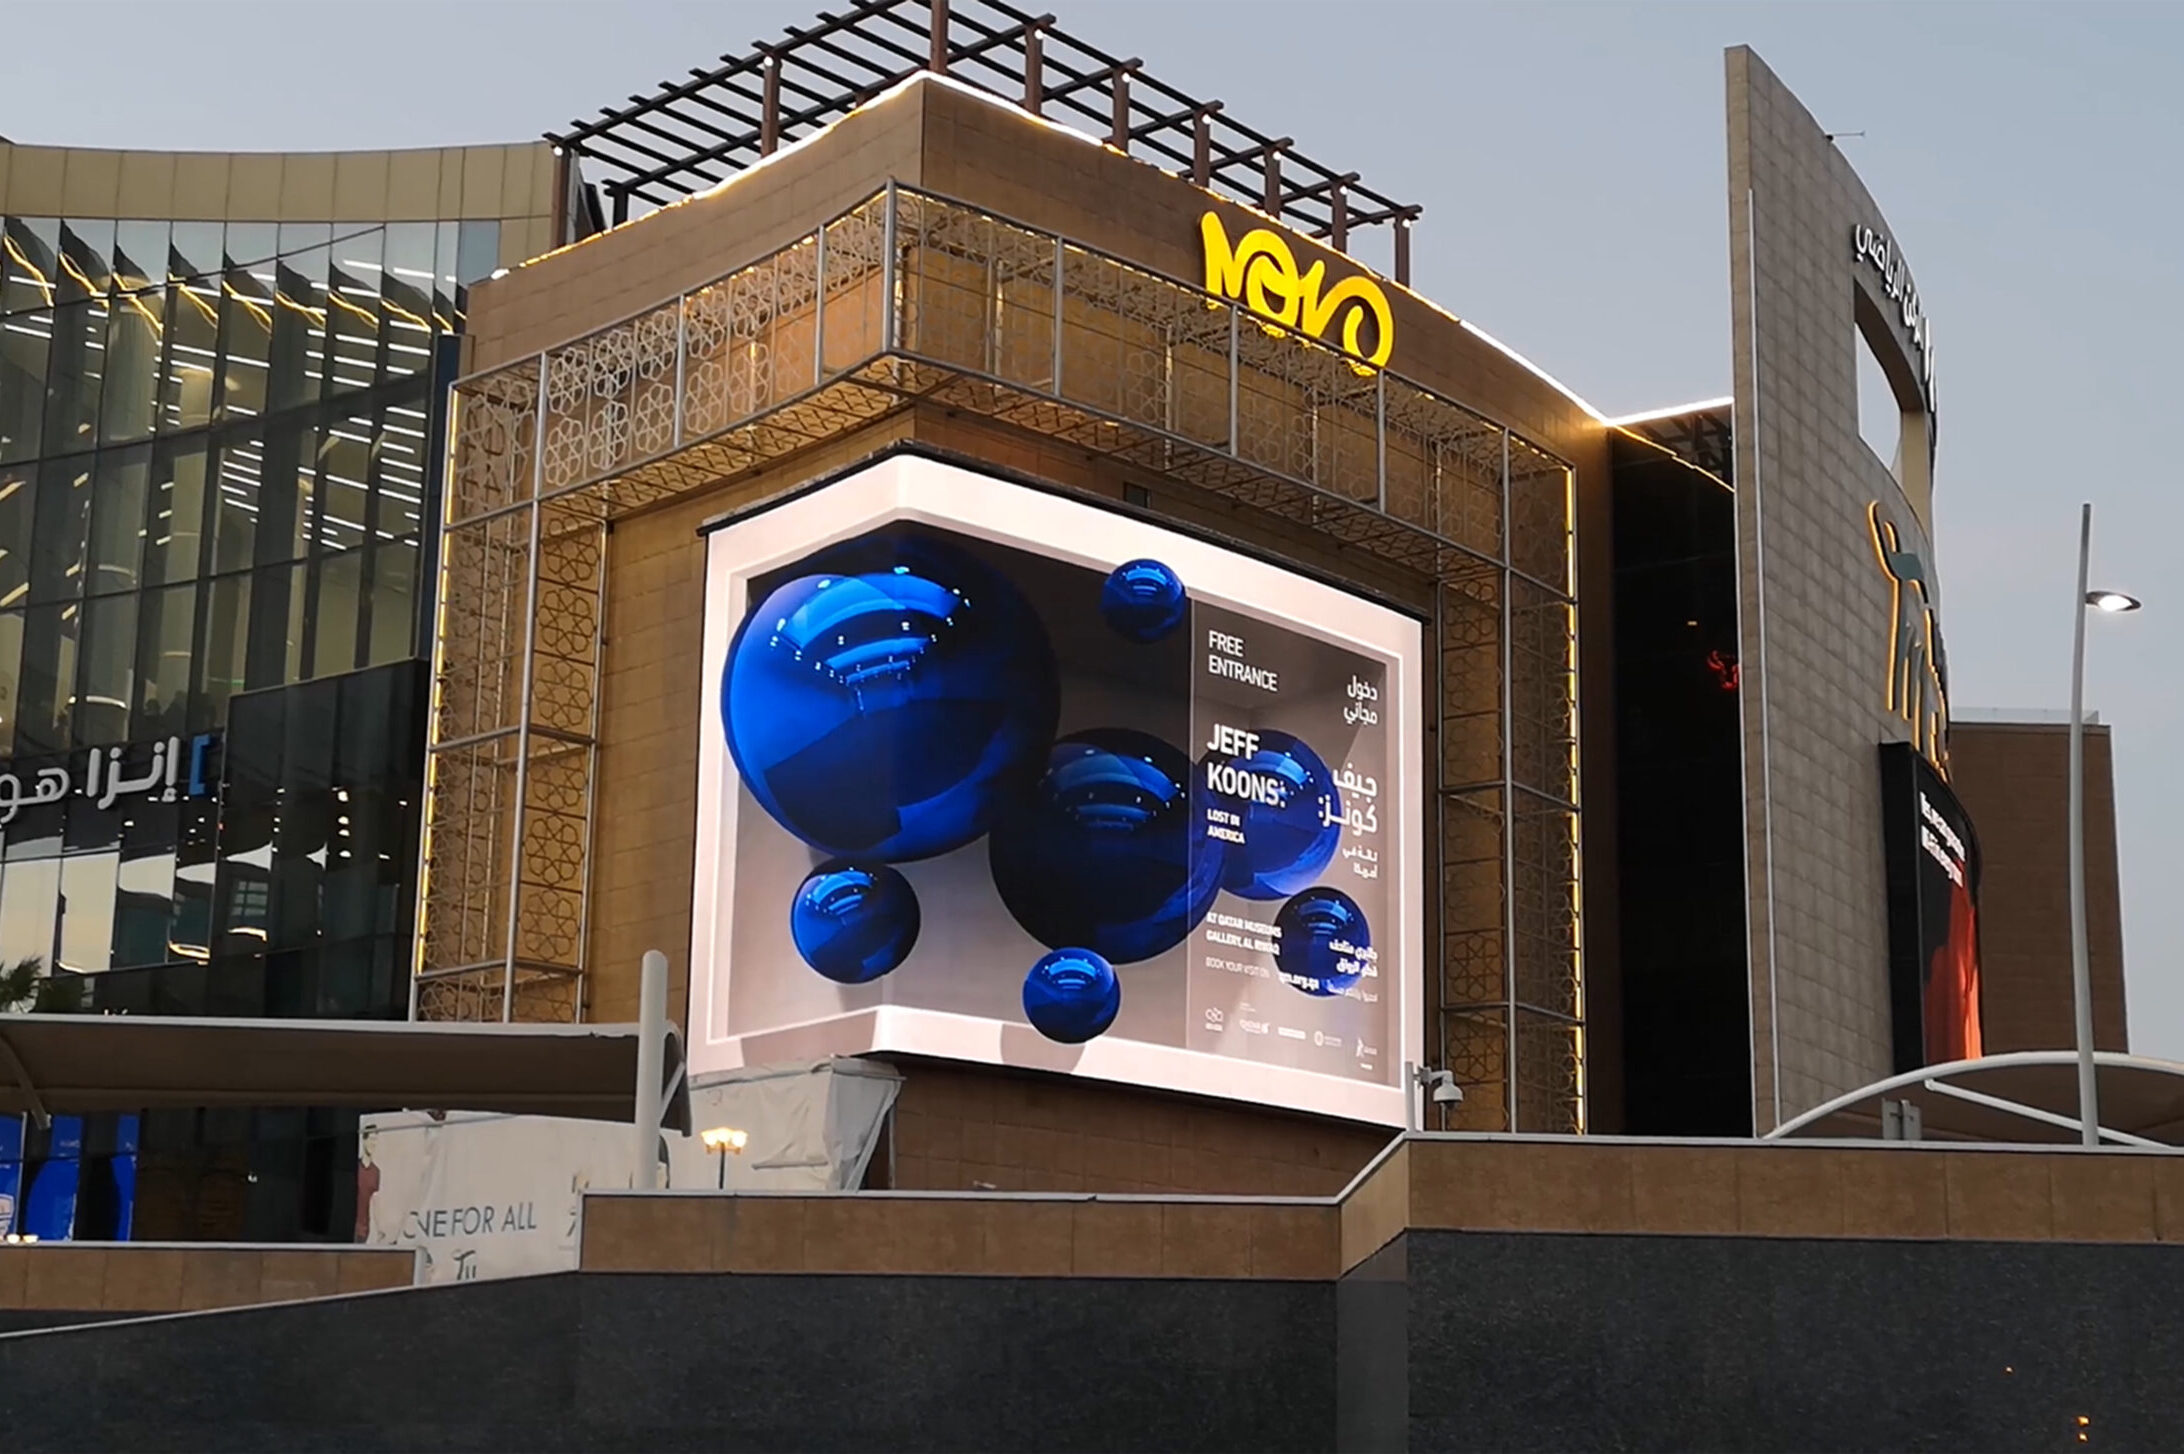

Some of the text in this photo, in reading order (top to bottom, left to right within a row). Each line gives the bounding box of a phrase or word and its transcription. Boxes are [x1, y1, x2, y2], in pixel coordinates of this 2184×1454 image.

[1208, 630, 1244, 657] FREE
[1208, 654, 1279, 692] ENTRANCE
[1347, 675, 1378, 701] دخول
[1343, 701, 1378, 725] مجاني
[1207, 723, 1260, 761] JEFF
[86, 736, 180, 810] إنزا
[1207, 762, 1286, 808] KOONS:
[1332, 762, 1378, 803] جيف
[1207, 808, 1230, 824] LOST
[1207, 825, 1245, 844] AMERICA
[1218, 914, 1243, 929] QATAR
[1205, 957, 1225, 969] BOOK
[1225, 961, 1242, 972] YOUR
[450, 1206, 496, 1236] FOR
[501, 1202, 537, 1232] ALL
